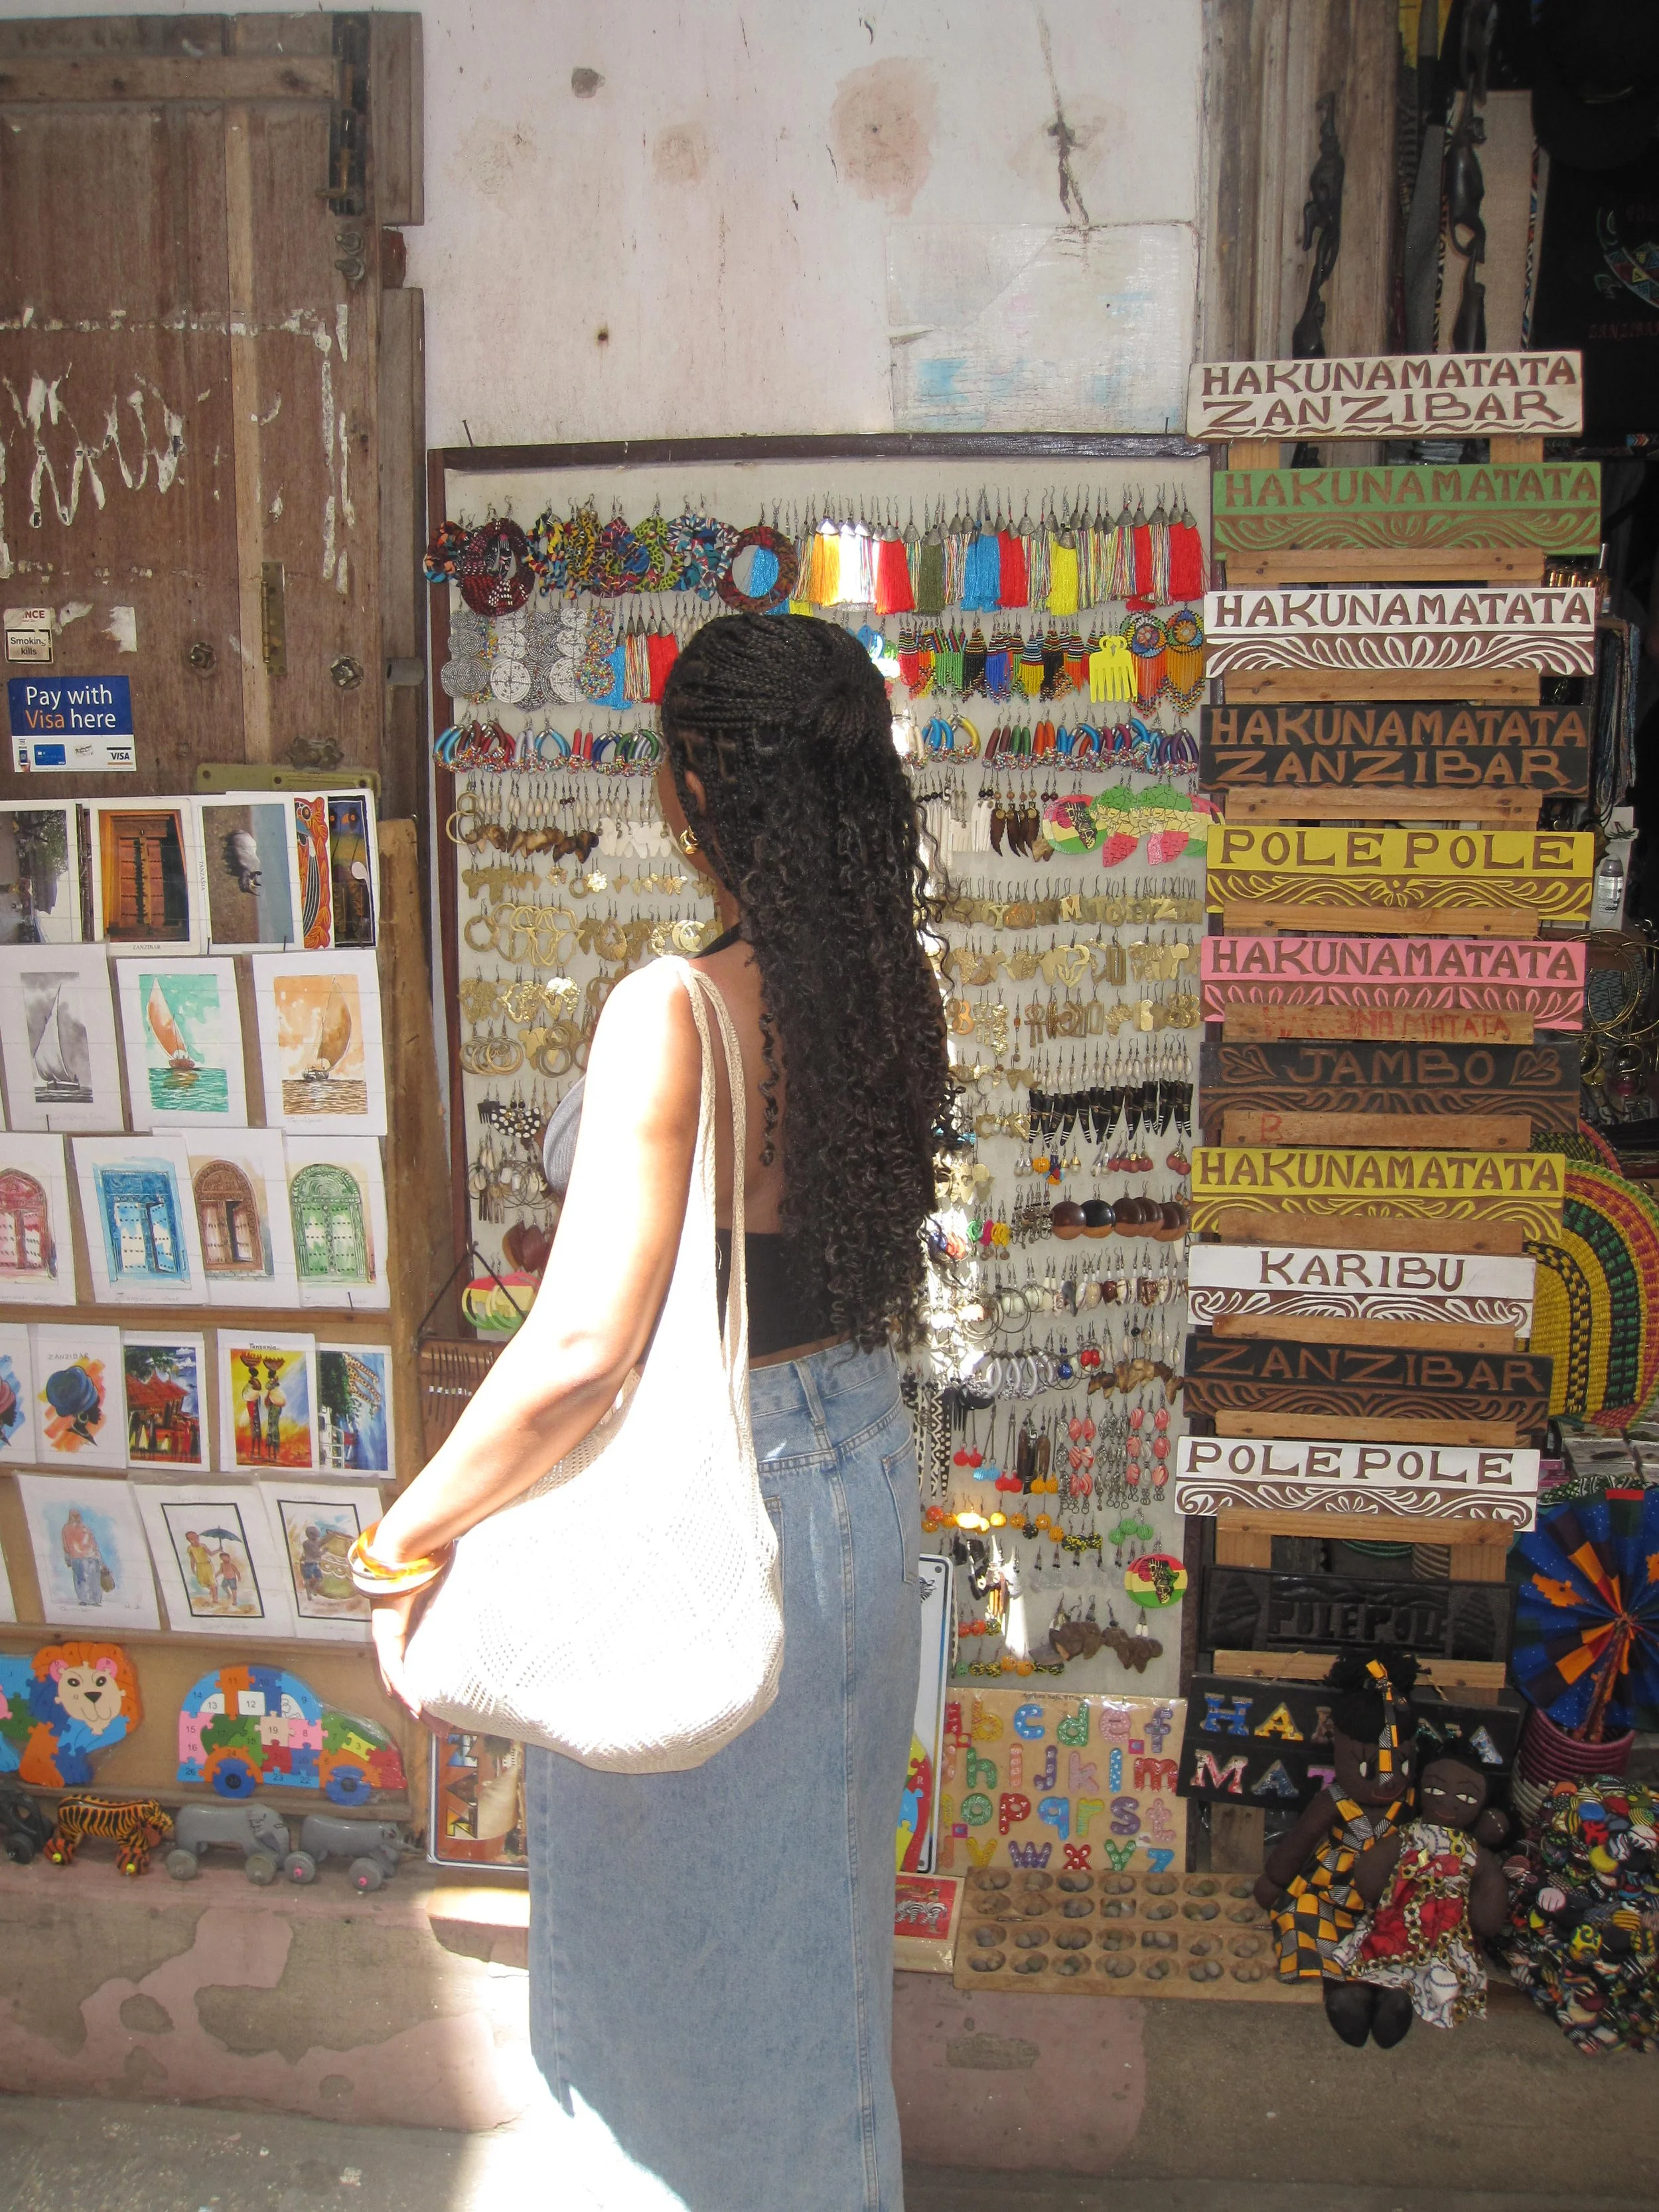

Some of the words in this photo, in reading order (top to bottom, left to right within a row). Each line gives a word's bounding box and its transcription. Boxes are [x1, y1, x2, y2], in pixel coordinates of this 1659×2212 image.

[1202, 392, 1565, 427] ZANZIBAR
[23, 610, 45, 619] NCE
[26, 686, 62, 711] Pay
[67, 684, 113, 705] with
[25, 709, 65, 729] Visa
[70, 708, 117, 728] here
[1215, 750, 1571, 784] ZANZIBAR
[1403, 1012, 1512, 1040] MATATA
[1283, 1048, 1496, 1085] JAMBO
[1259, 1250, 1466, 1291] KARIBU
[1196, 1341, 1546, 1392] ZANZIBAR
